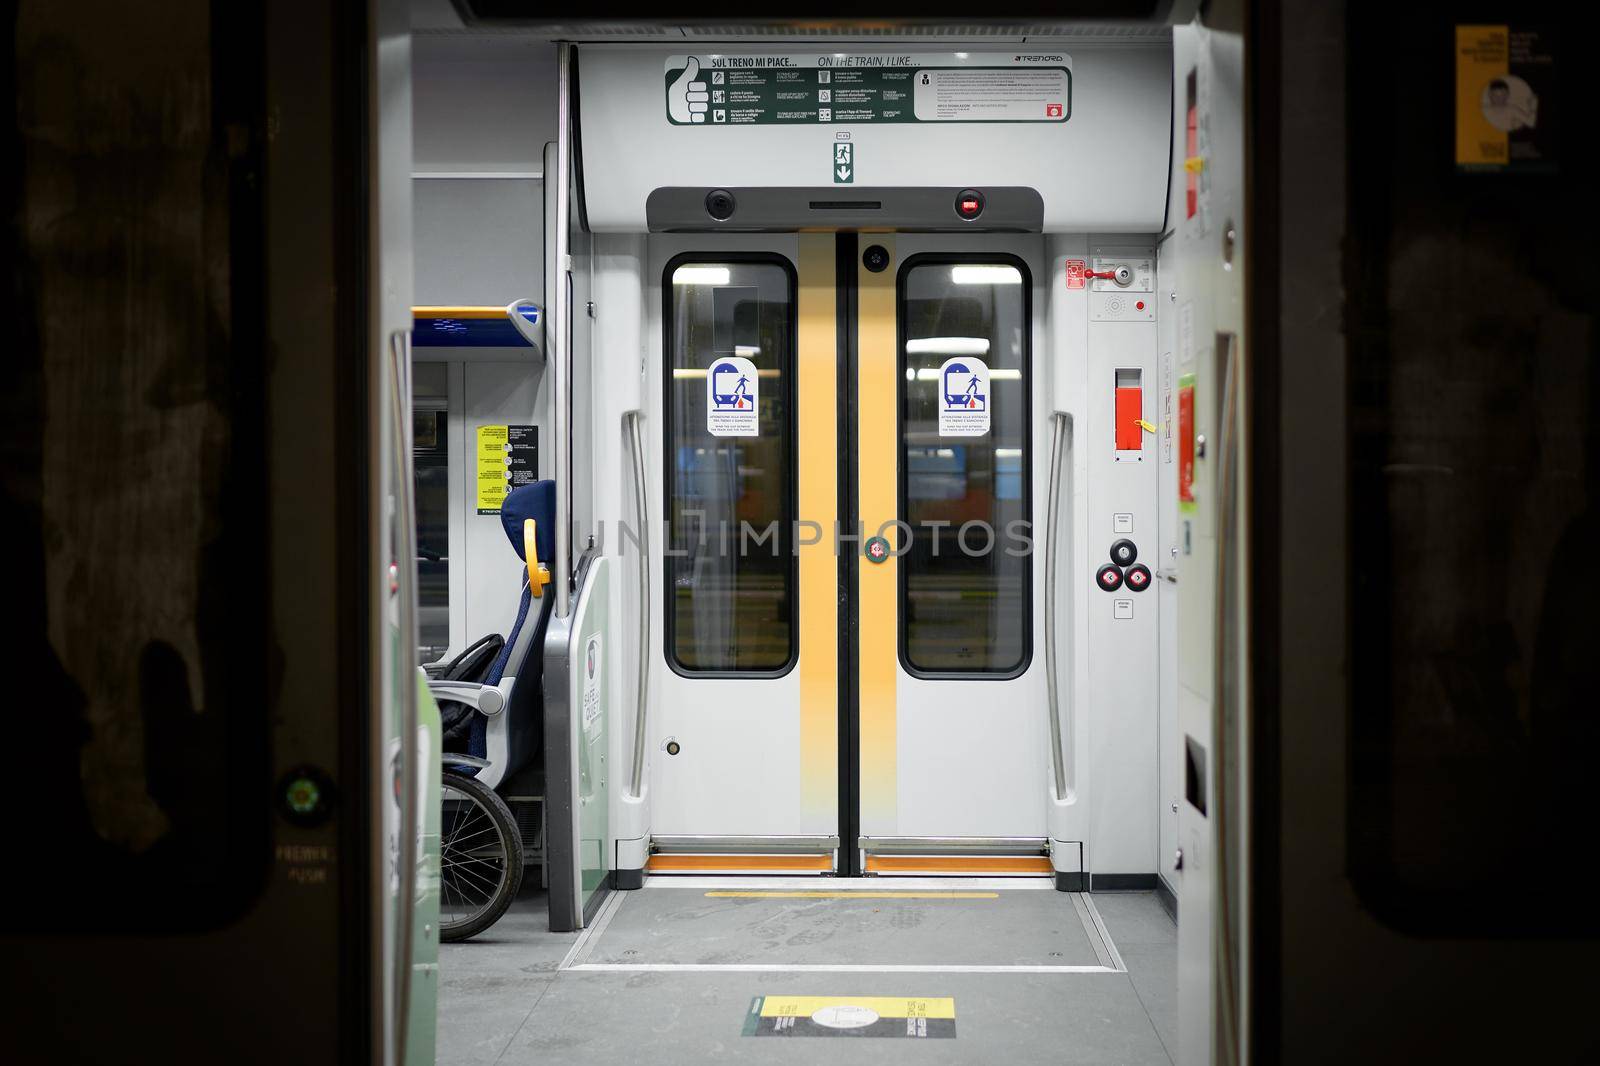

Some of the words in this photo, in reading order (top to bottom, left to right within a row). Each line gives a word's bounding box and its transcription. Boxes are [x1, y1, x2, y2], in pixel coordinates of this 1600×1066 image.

[712, 57, 727, 68] SUL
[728, 57, 754, 68] TRENO
[756, 57, 766, 68] MI
[767, 57, 797, 68] PIACE...
[817, 56, 834, 67] ON
[836, 56, 853, 67] THE
[855, 56, 884, 67] TRAIN,
[886, 56, 890, 67] I
[891, 56, 921, 67] LIKE...
